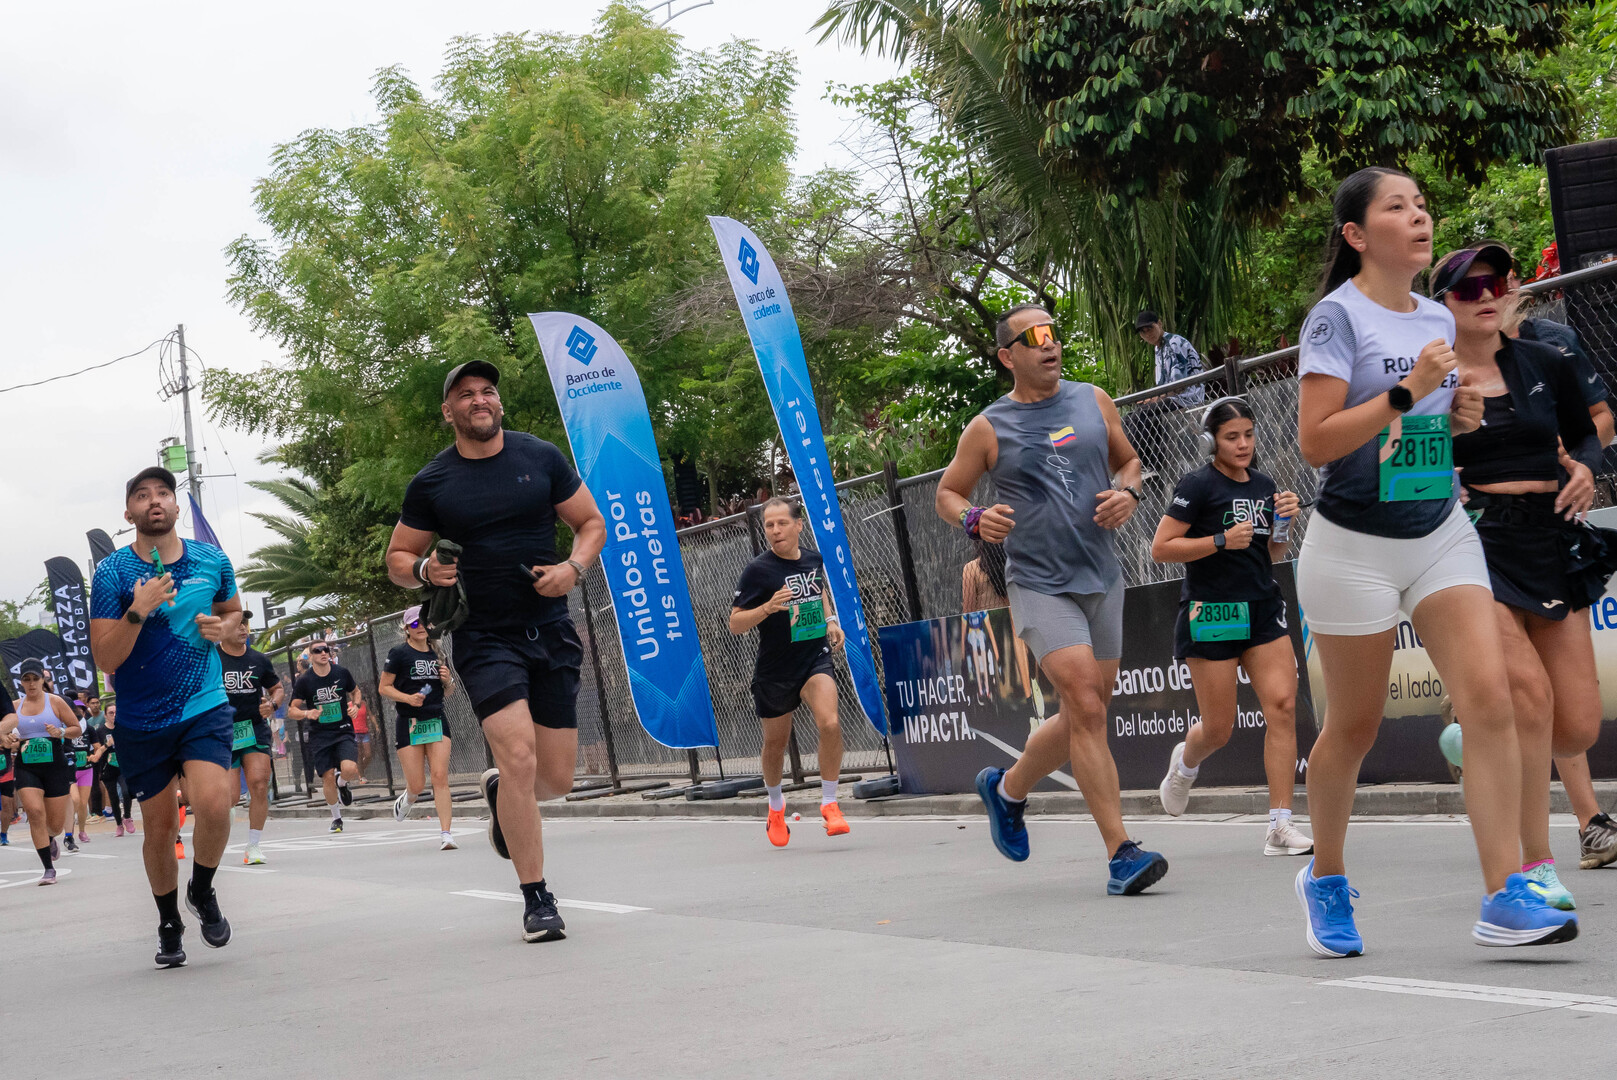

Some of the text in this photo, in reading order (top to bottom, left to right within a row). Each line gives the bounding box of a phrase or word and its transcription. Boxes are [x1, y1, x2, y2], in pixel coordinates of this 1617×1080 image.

[746, 287, 775, 304] anco de
[753, 303, 781, 320] ccidente
[566, 367, 616, 386] Banco de
[567, 381, 622, 399] Occidente
[1391, 437, 1445, 467] 28157
[1233, 499, 1269, 527] 5K
[606, 489, 660, 660] Unidos por
[636, 490, 683, 641] tus metas
[785, 571, 821, 599] 5K
[55, 584, 79, 656] LAZZA
[71, 583, 89, 655] GLOBAL
[795, 610, 822, 628] 25063
[1196, 604, 1240, 622] 28304
[415, 660, 438, 675] 5K
[1112, 656, 1193, 696] Banco de
[224, 671, 253, 689] 5K
[896, 674, 971, 708] TU HACER,
[1387, 671, 1442, 699] el lado
[317, 685, 339, 701] 5K
[234, 727, 248, 739] 337
[413, 723, 436, 735] 26011
[903, 711, 977, 744] IMPACTA.
[1115, 713, 1136, 737] Del
[1137, 707, 1166, 736] lado
[1168, 709, 1185, 734] de
[24, 743, 48, 754] 27456
